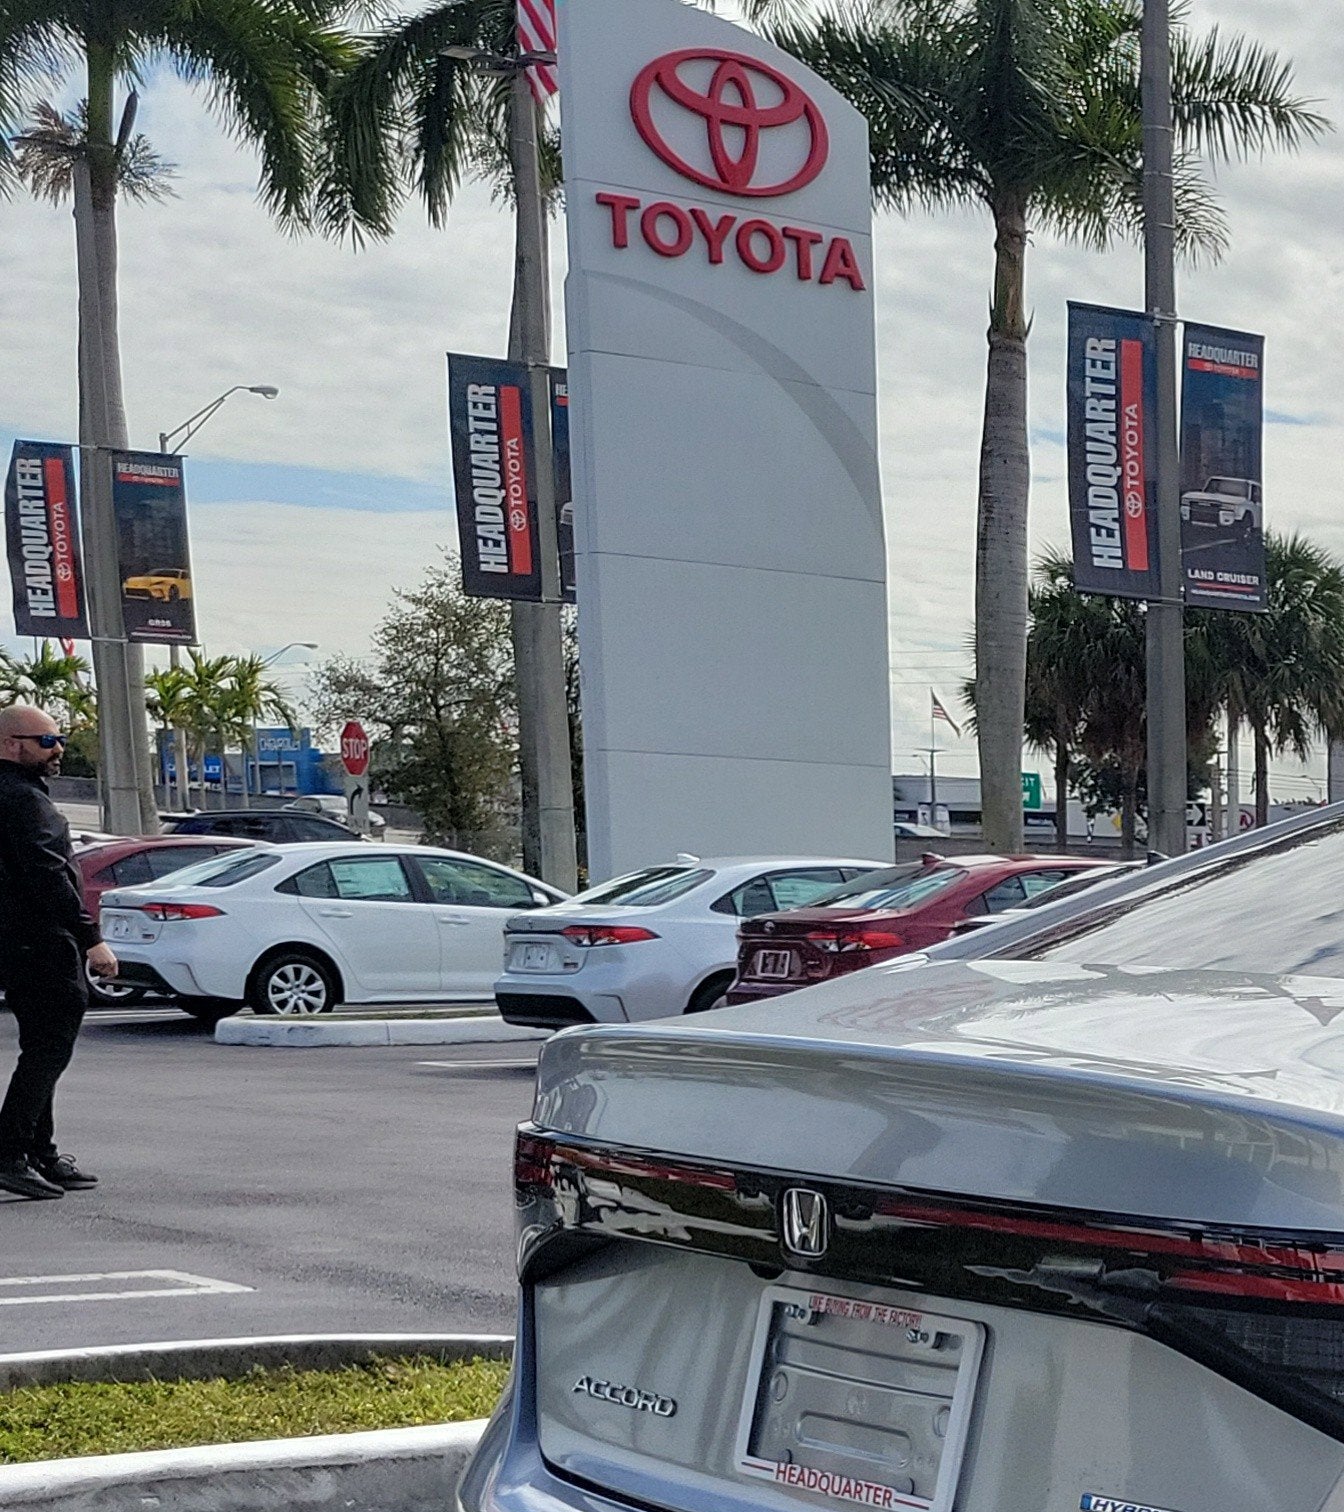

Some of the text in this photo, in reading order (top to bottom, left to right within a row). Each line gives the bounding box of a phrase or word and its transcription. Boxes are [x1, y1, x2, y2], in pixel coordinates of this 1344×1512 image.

[595, 192, 867, 291] TOYOTA
[467, 383, 509, 574] HEADQUARTER
[507, 437, 524, 508] TOYOTA
[1085, 336, 1124, 570] HEADQUARTER
[1124, 404, 1139, 489] TOYOTA
[16, 457, 57, 618] HEADQUARTER
[53, 501, 69, 560] TOYOTA
[1188, 569, 1259, 586] LAND CRUISER
[342, 738, 367, 759] STOP
[572, 1375, 678, 1417] ACCORD
[776, 1461, 892, 1508] HEADQUARTER
